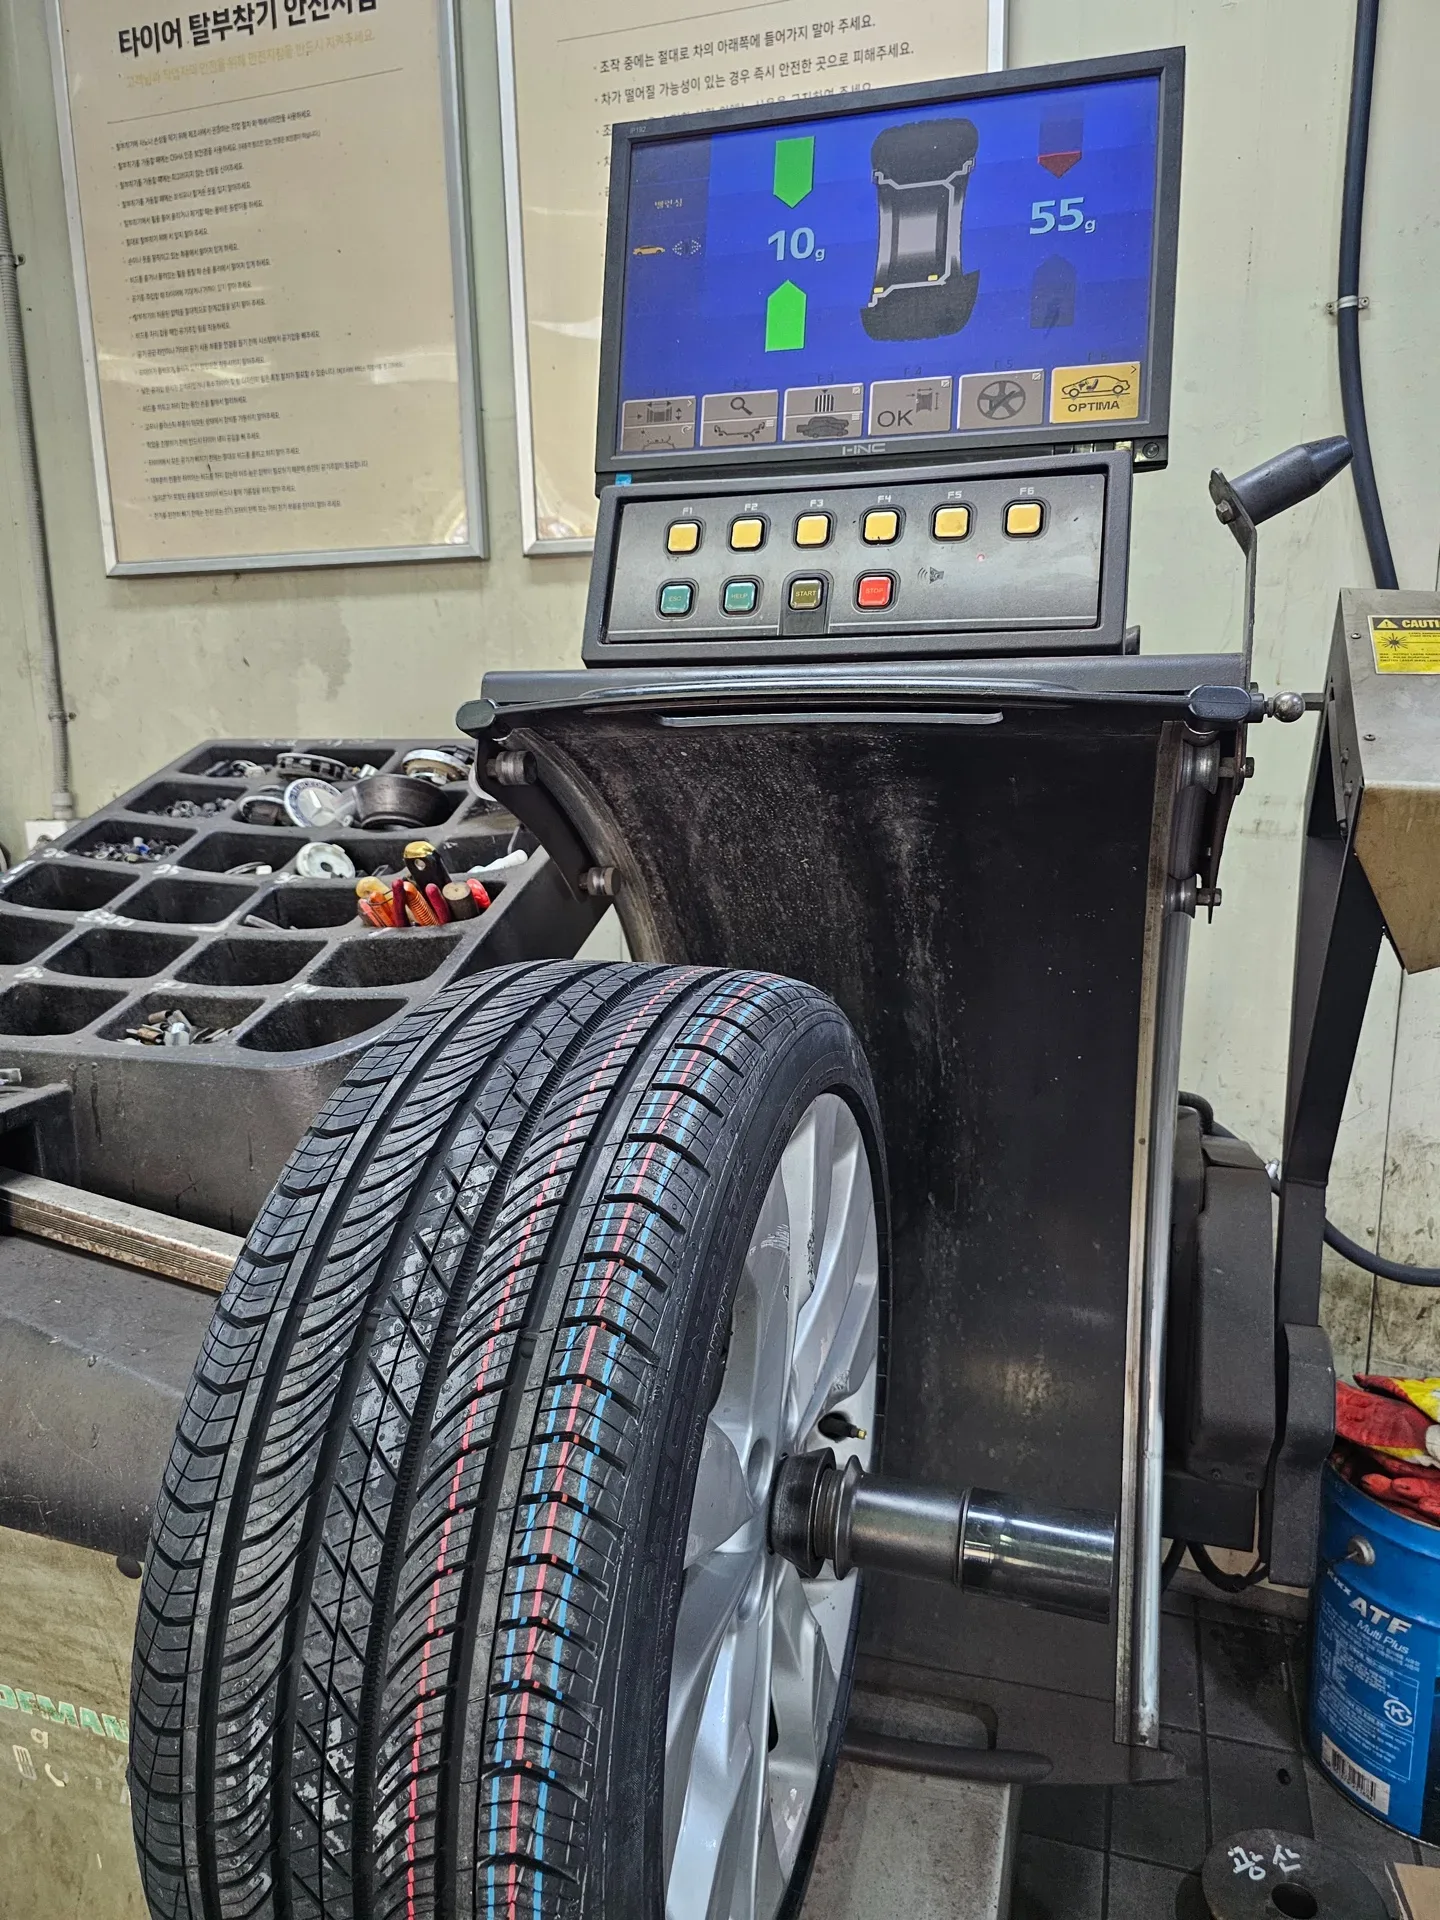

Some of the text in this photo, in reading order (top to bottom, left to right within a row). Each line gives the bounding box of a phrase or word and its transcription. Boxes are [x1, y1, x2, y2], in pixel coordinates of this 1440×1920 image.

[118, 17, 182, 58] 타이어
[188, 0, 278, 47] 탈부착기
[600, 14, 876, 73] 조작 중에는 절대로 차의 아래쪽에 들어가지 말아 주세요.
[601, 41, 914, 106] 차가 떨어질 가능성이 있는 경우 즉시 안전한 곳으로 피해주세요.
[877, 409, 914, 428] OK
[1068, 401, 1121, 413] OPTIMA
[682, 487, 1035, 516] F1 F2 F3 F4 F5 F6
[1348, 1597, 1412, 1634] ATF
[1356, 1620, 1410, 1655] Multi Plus
